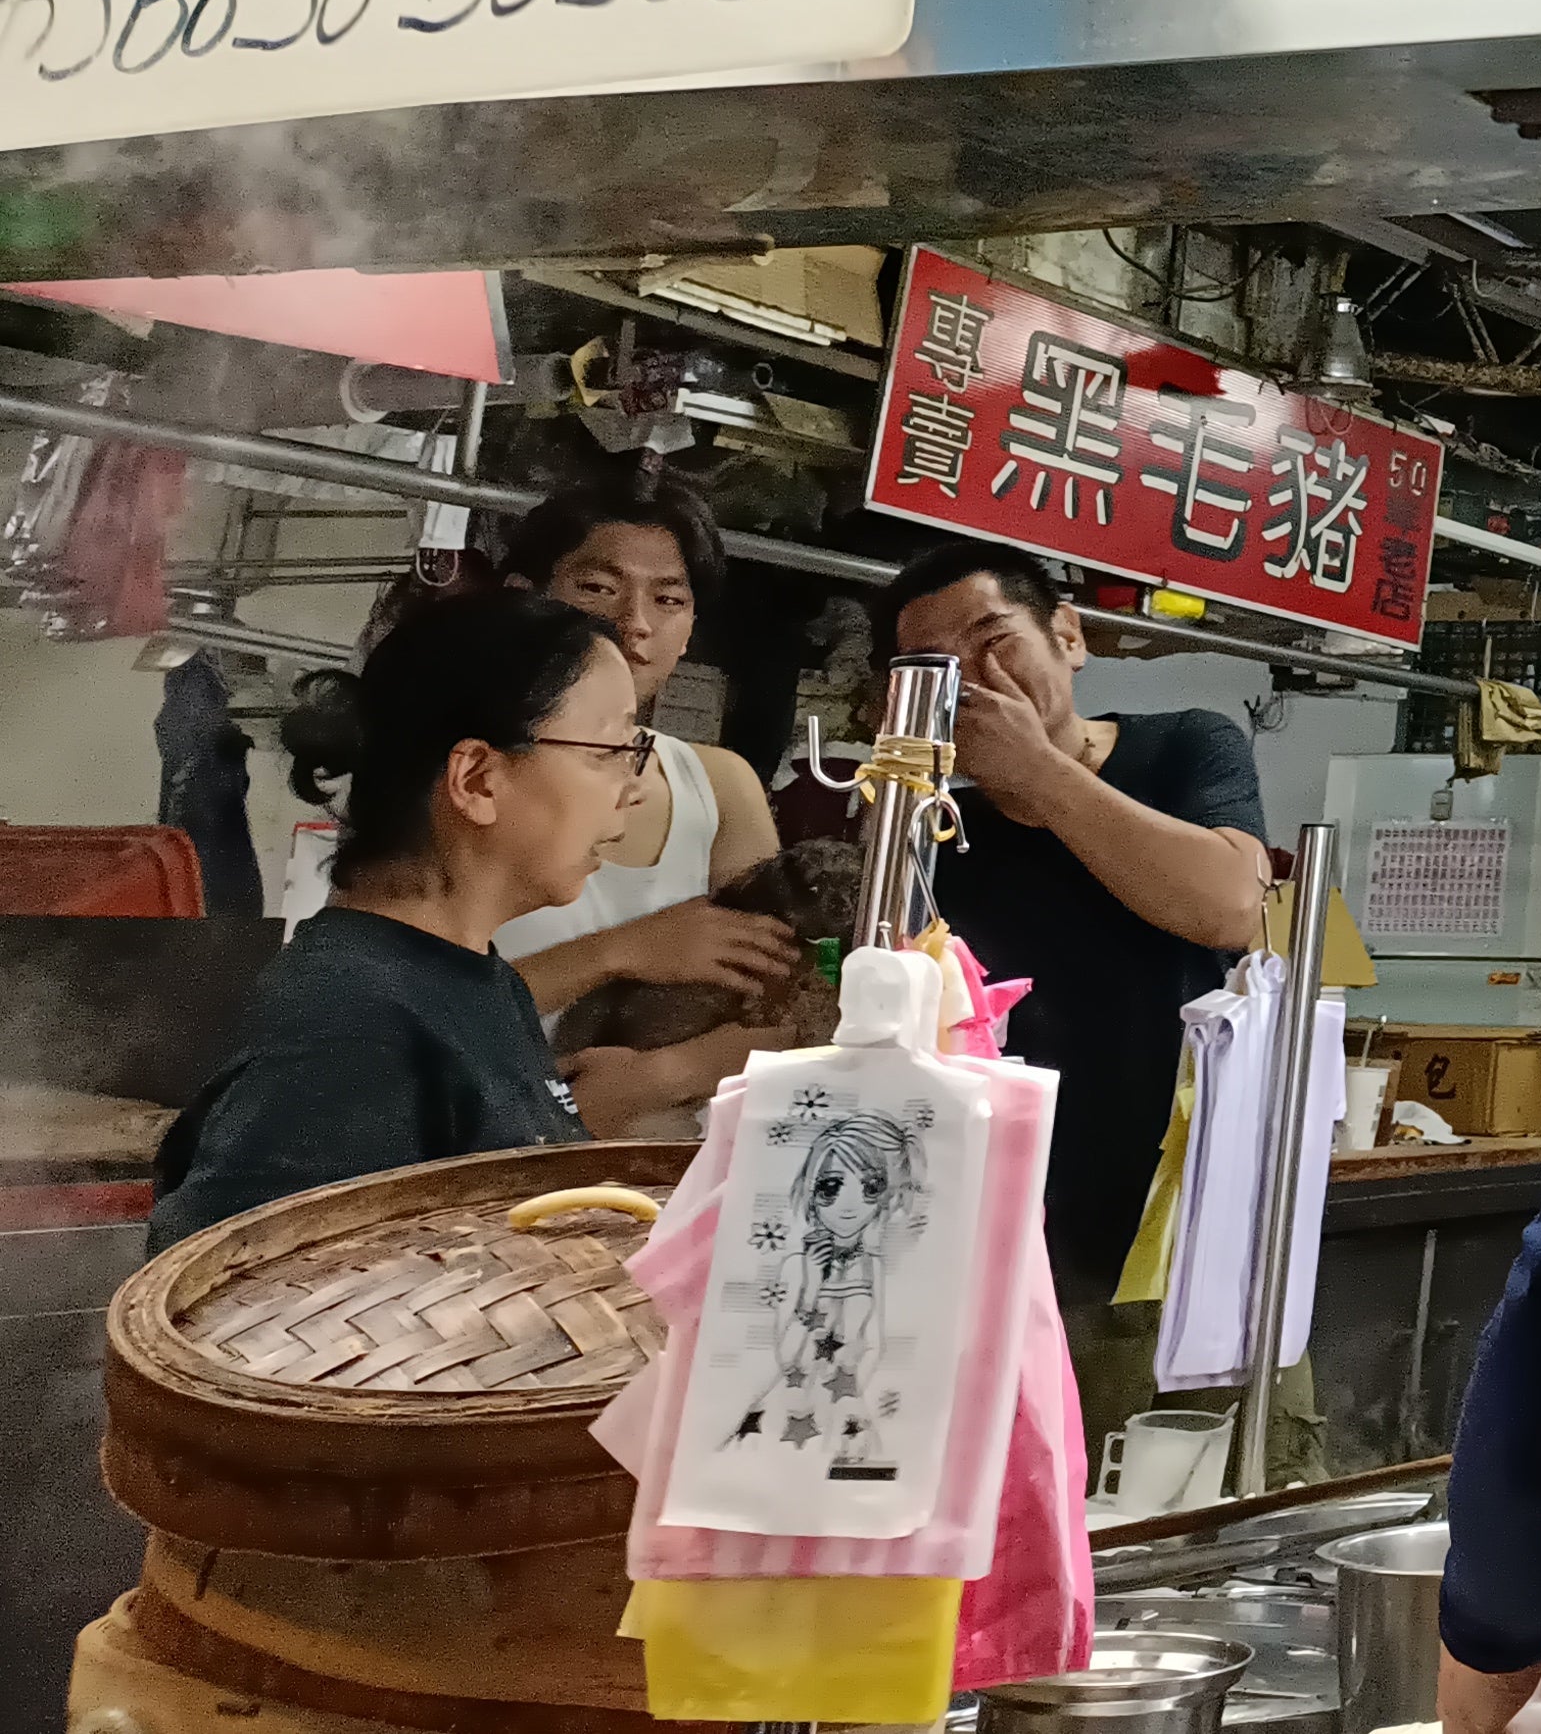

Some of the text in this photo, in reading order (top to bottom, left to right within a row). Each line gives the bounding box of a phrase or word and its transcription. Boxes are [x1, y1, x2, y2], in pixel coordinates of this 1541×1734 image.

[897, 289, 995, 499] 專賣
[991, 330, 1370, 594] 黑毛豬
